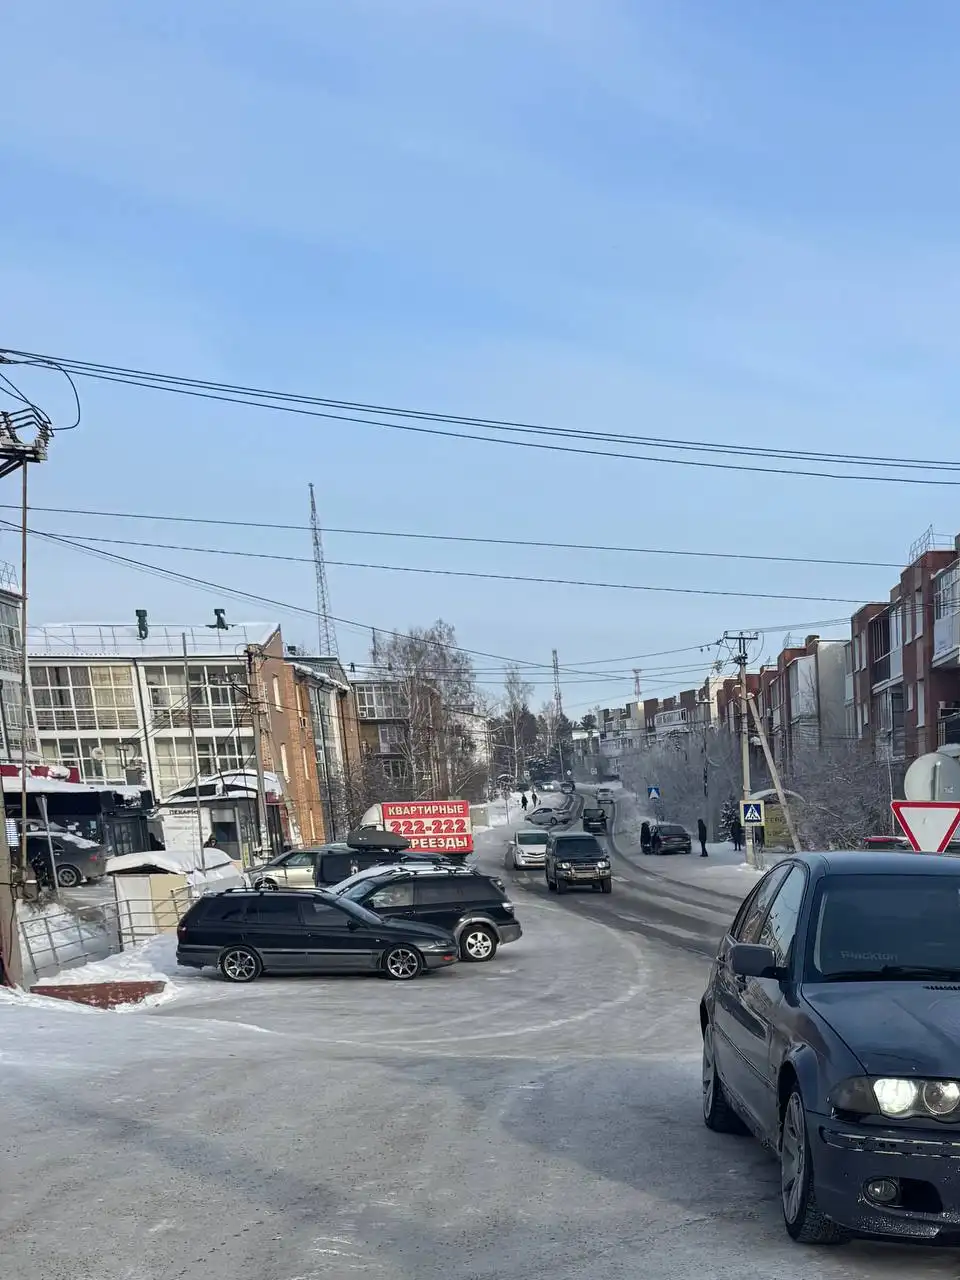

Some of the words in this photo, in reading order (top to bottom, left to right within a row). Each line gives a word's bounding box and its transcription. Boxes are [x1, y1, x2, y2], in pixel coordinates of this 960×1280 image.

[388, 804, 464, 816] КВАРТИРНЫЕ
[390, 819, 467, 835] 222-222
[409, 837, 468, 850] РЕЕЗДЫ
